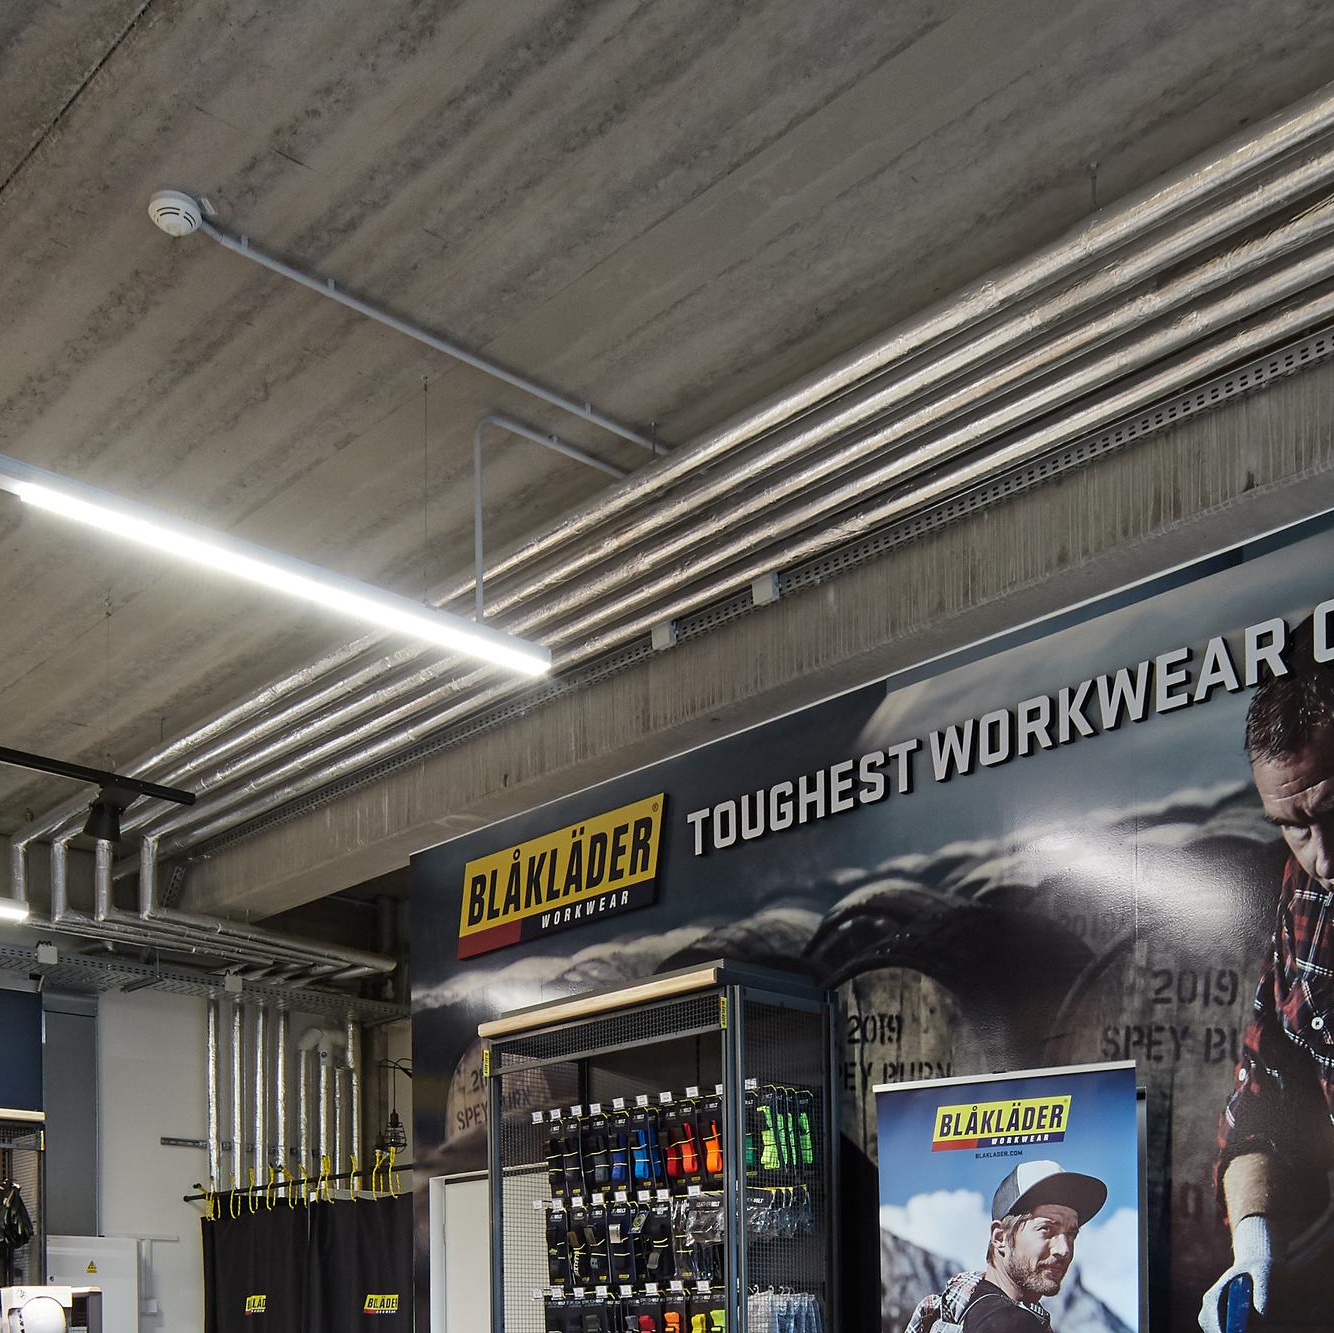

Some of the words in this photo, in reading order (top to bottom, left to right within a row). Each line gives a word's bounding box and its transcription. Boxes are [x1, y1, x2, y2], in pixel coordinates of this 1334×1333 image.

[687, 738, 917, 856] TOUGHEST
[929, 616, 1288, 783] WORKWEAR
[467, 816, 653, 927] BLÅKLÄDER
[541, 890, 630, 929] WORKWEAR
[1153, 968, 1239, 1007] 2019
[939, 1102, 1064, 1138] BLÅKLÄDER
[991, 1133, 1050, 1145] WORKWEAR
